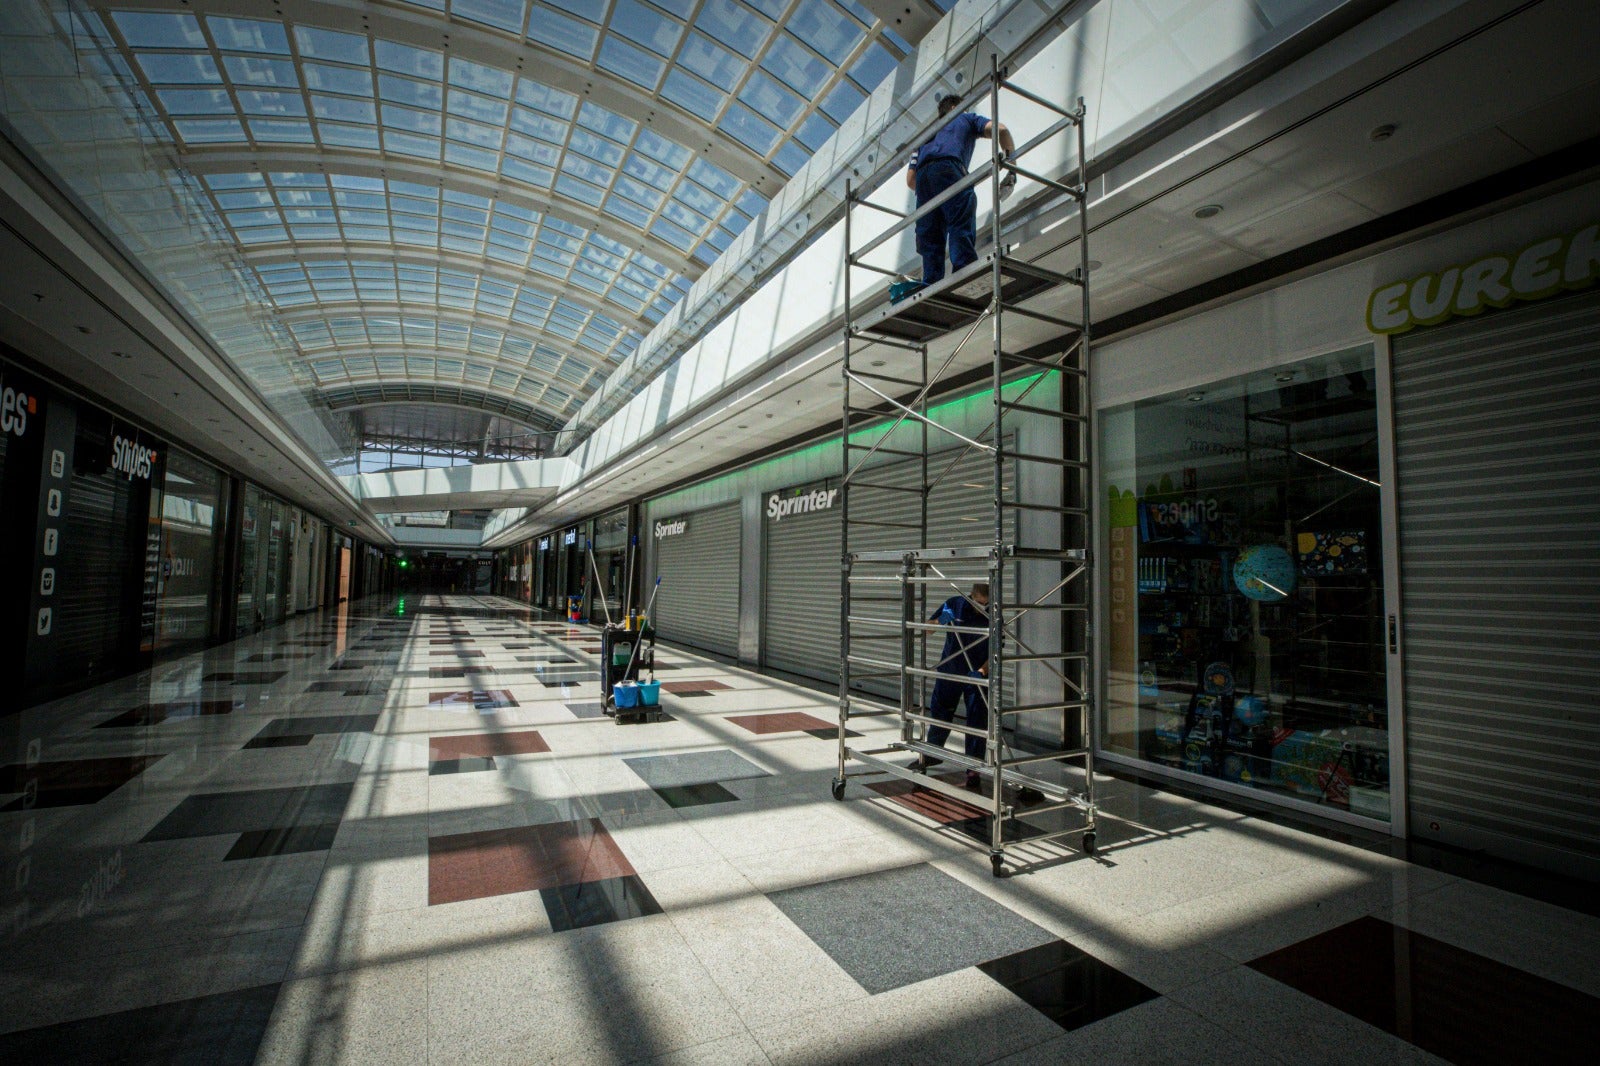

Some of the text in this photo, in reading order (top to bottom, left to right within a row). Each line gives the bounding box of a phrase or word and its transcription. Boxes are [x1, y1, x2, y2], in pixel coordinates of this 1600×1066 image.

[111, 435, 153, 482] snipes
[767, 489, 838, 522] Sprinter
[655, 519, 687, 541] Sprinter
